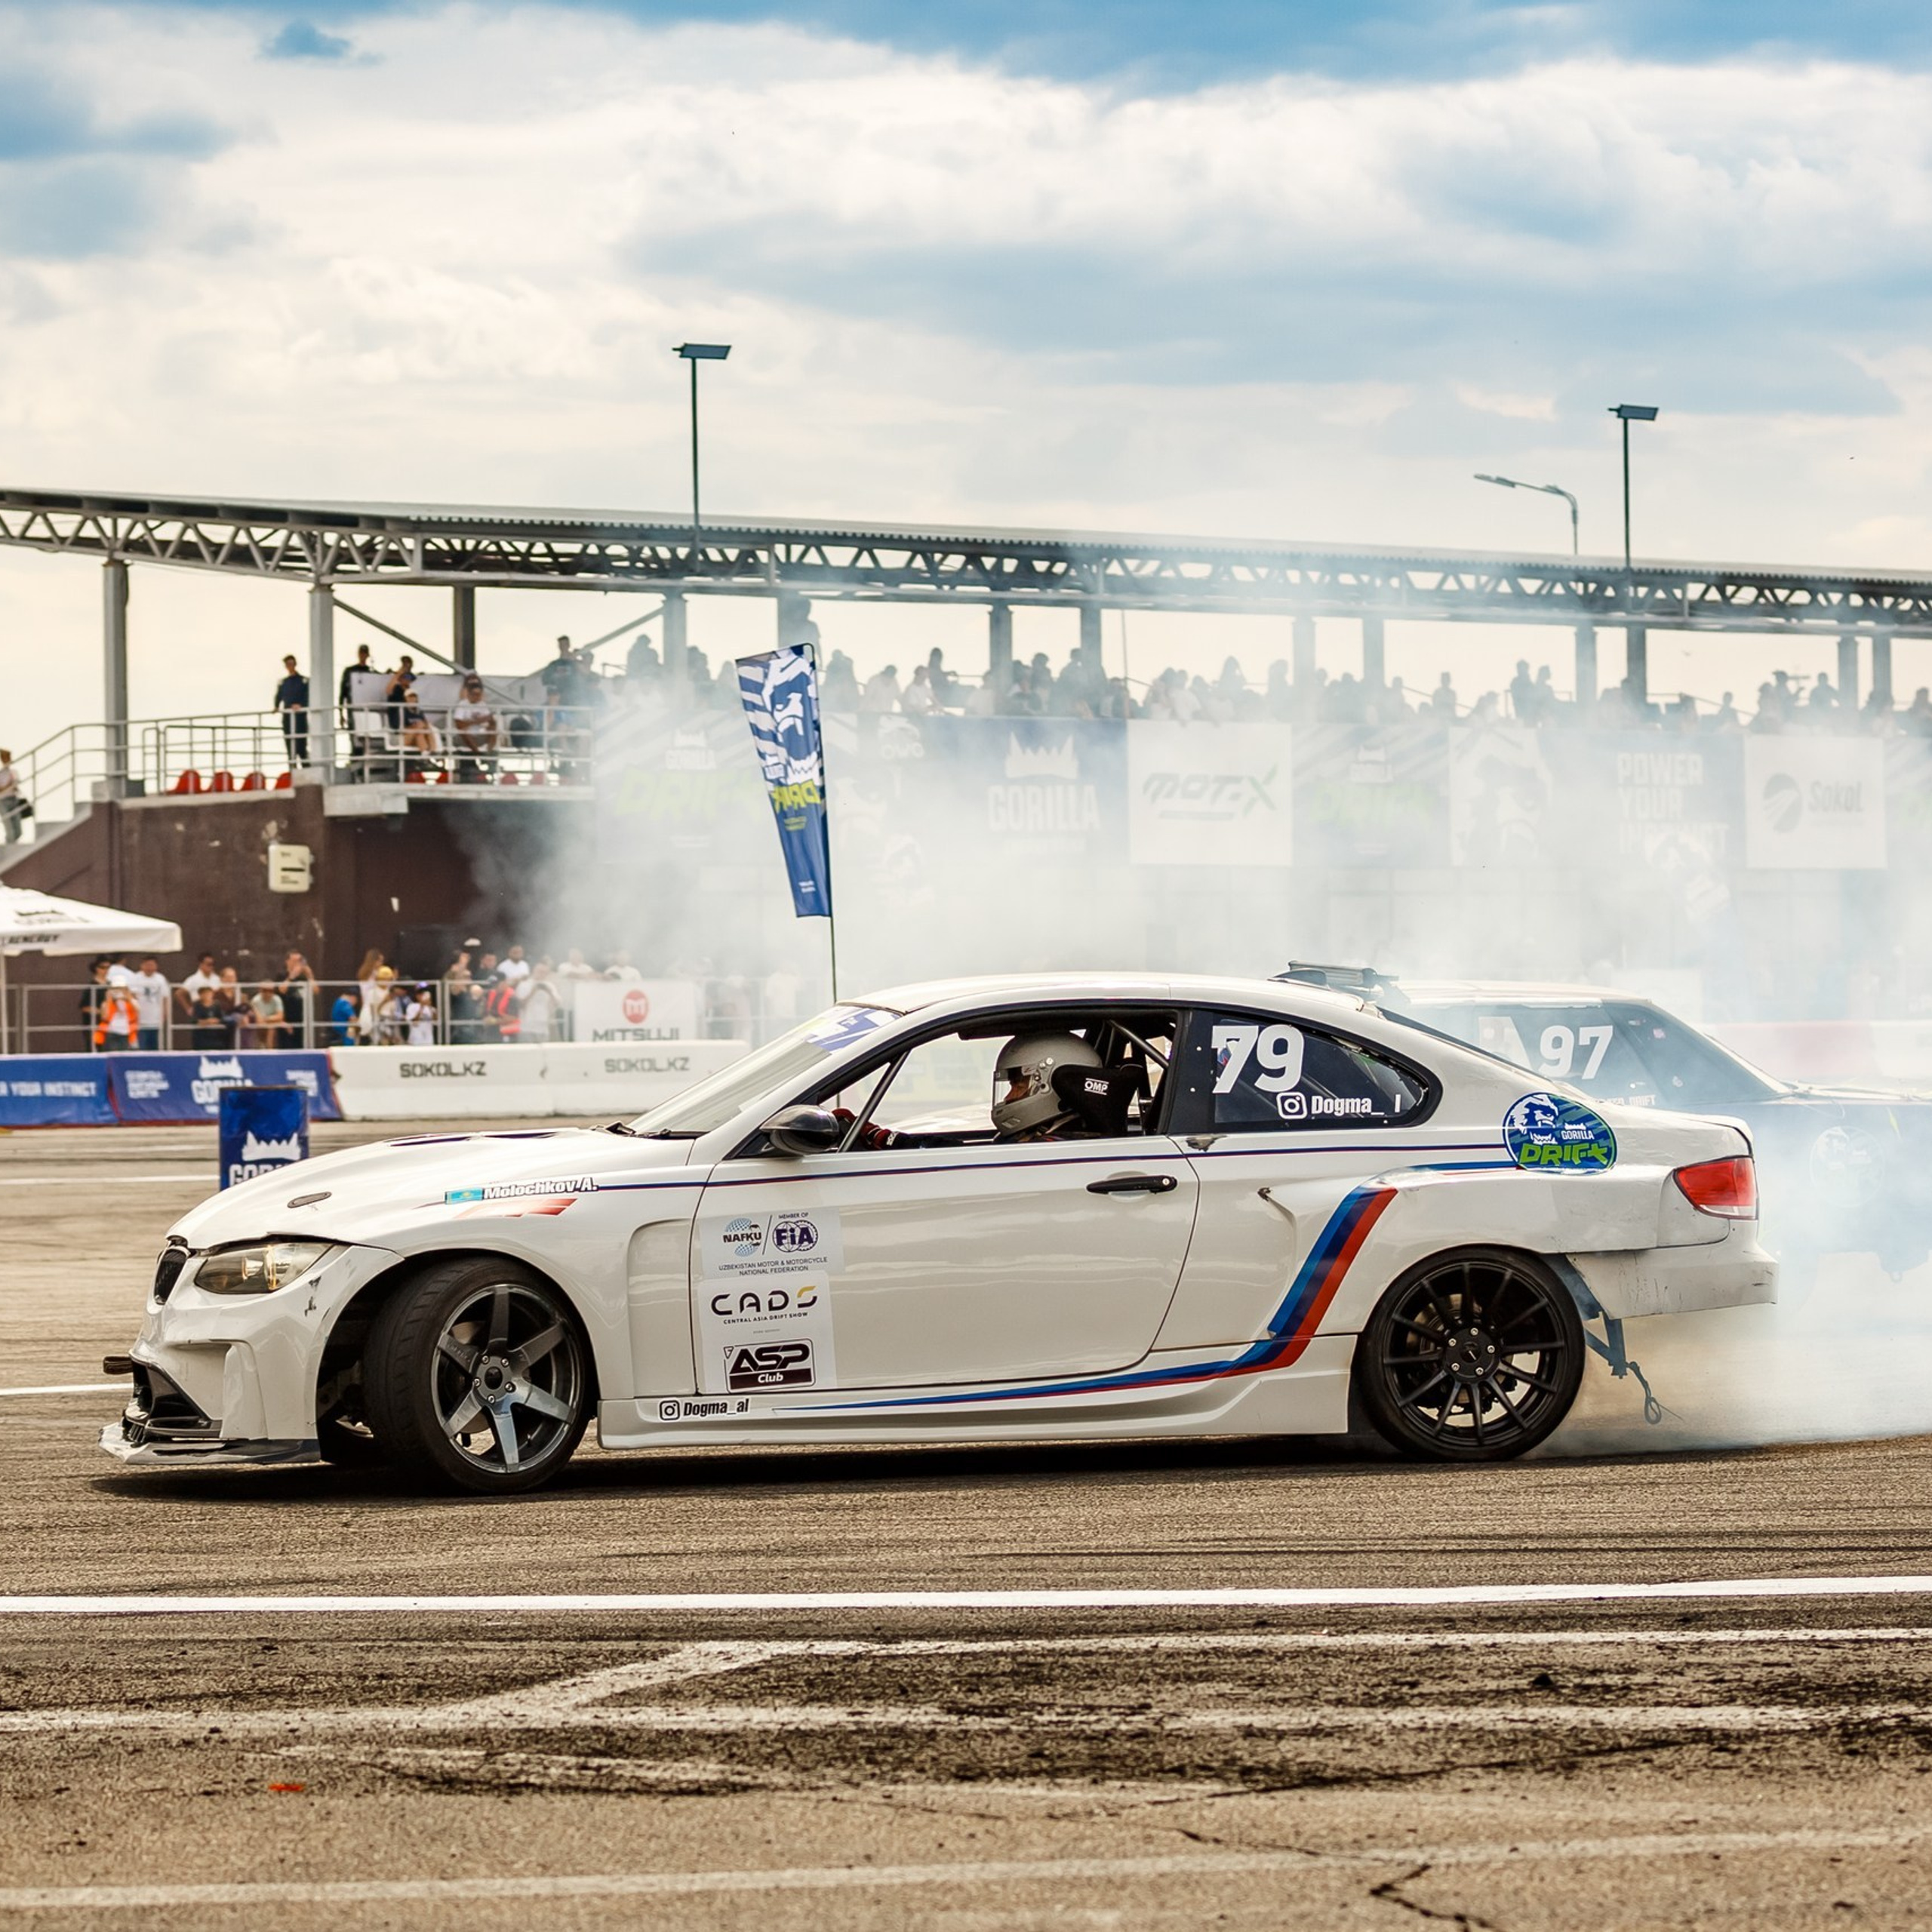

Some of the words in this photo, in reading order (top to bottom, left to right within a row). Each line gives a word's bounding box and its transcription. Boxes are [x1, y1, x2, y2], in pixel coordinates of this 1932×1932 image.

[1617, 752, 1704, 786] POWER
[988, 785, 1101, 831] GORILLA
[1618, 786, 1684, 820] YOUR
[1211, 1024, 1304, 1094] 79
[1538, 1025, 1614, 1079] 97
[1084, 1081, 1108, 1092] OMP
[1561, 1131, 1595, 1140] GORILLA
[1518, 1143, 1607, 1166] DRIFT
[484, 1180, 577, 1199] Molochkov
[723, 1232, 762, 1243] NAFKU
[718, 1263, 755, 1271] UZBEKISTAN
[786, 1257, 828, 1266] MOTORCYCLE
[770, 1266, 808, 1274] FEDERATION
[711, 1285, 818, 1316] CADS
[729, 1343, 810, 1374] ASP
[757, 1372, 784, 1383] Club
[684, 1398, 749, 1417] Dogma_al
